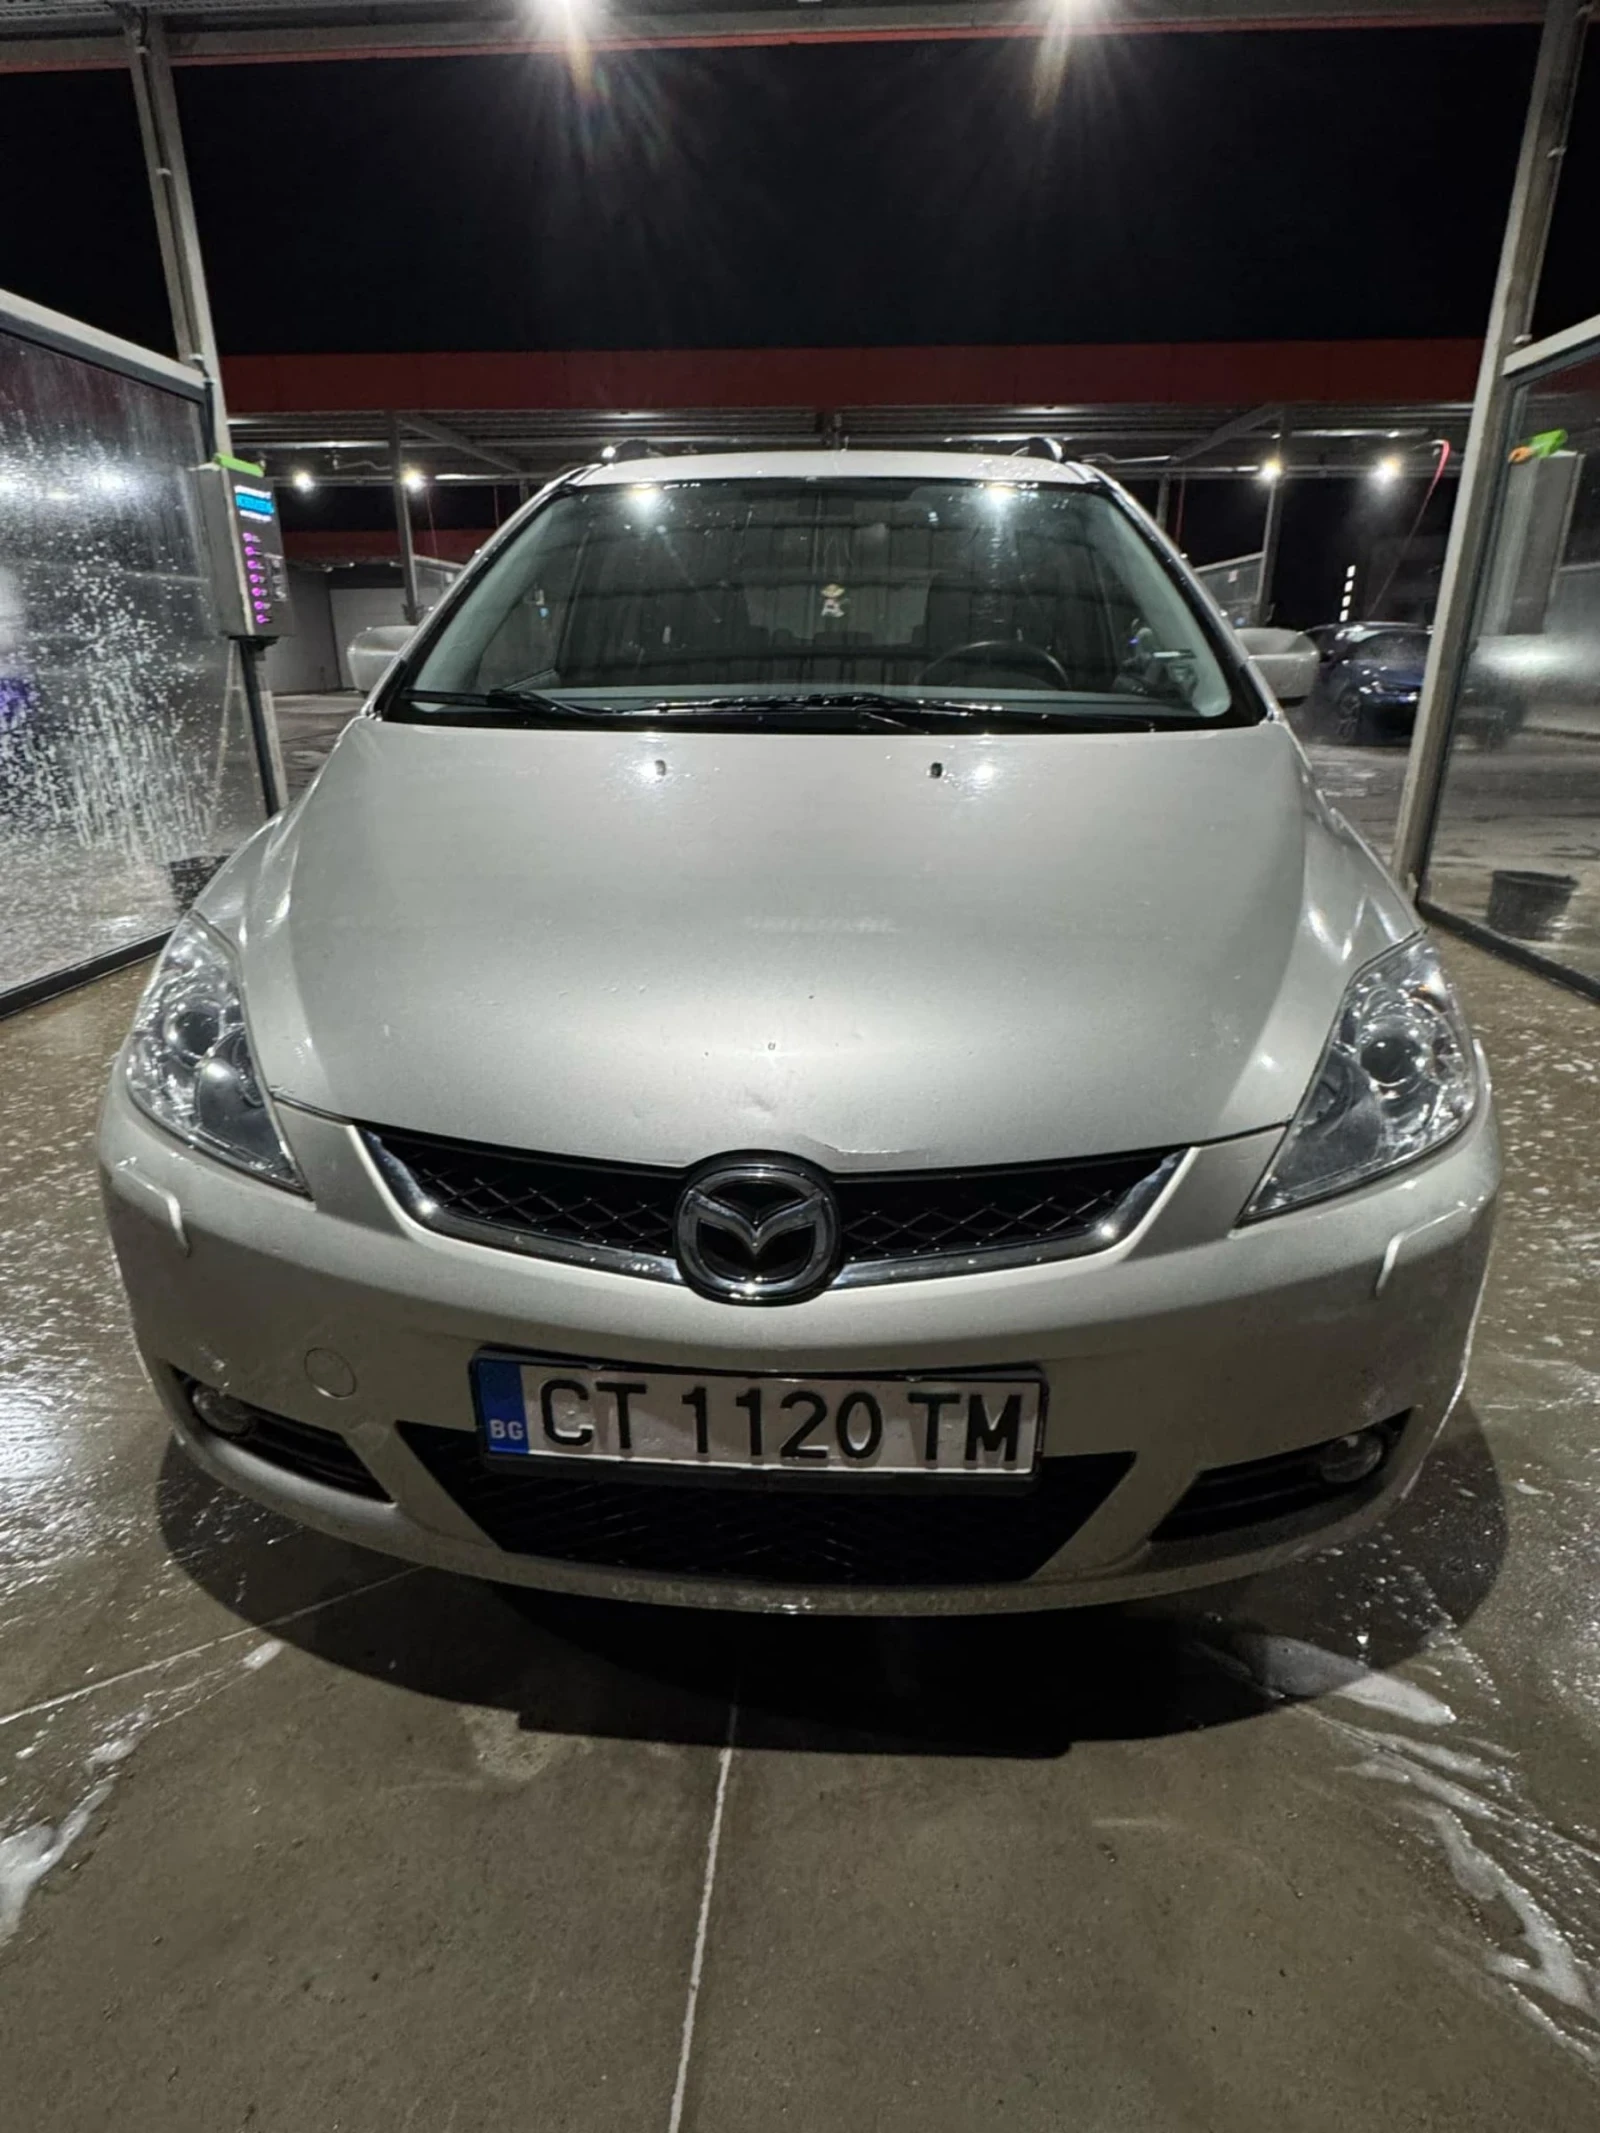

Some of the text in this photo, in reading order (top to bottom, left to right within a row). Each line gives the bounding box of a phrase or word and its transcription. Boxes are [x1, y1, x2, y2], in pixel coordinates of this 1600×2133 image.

[490, 1418, 525, 1441] BG
[539, 1378, 1023, 1463] CT 1120 TM
